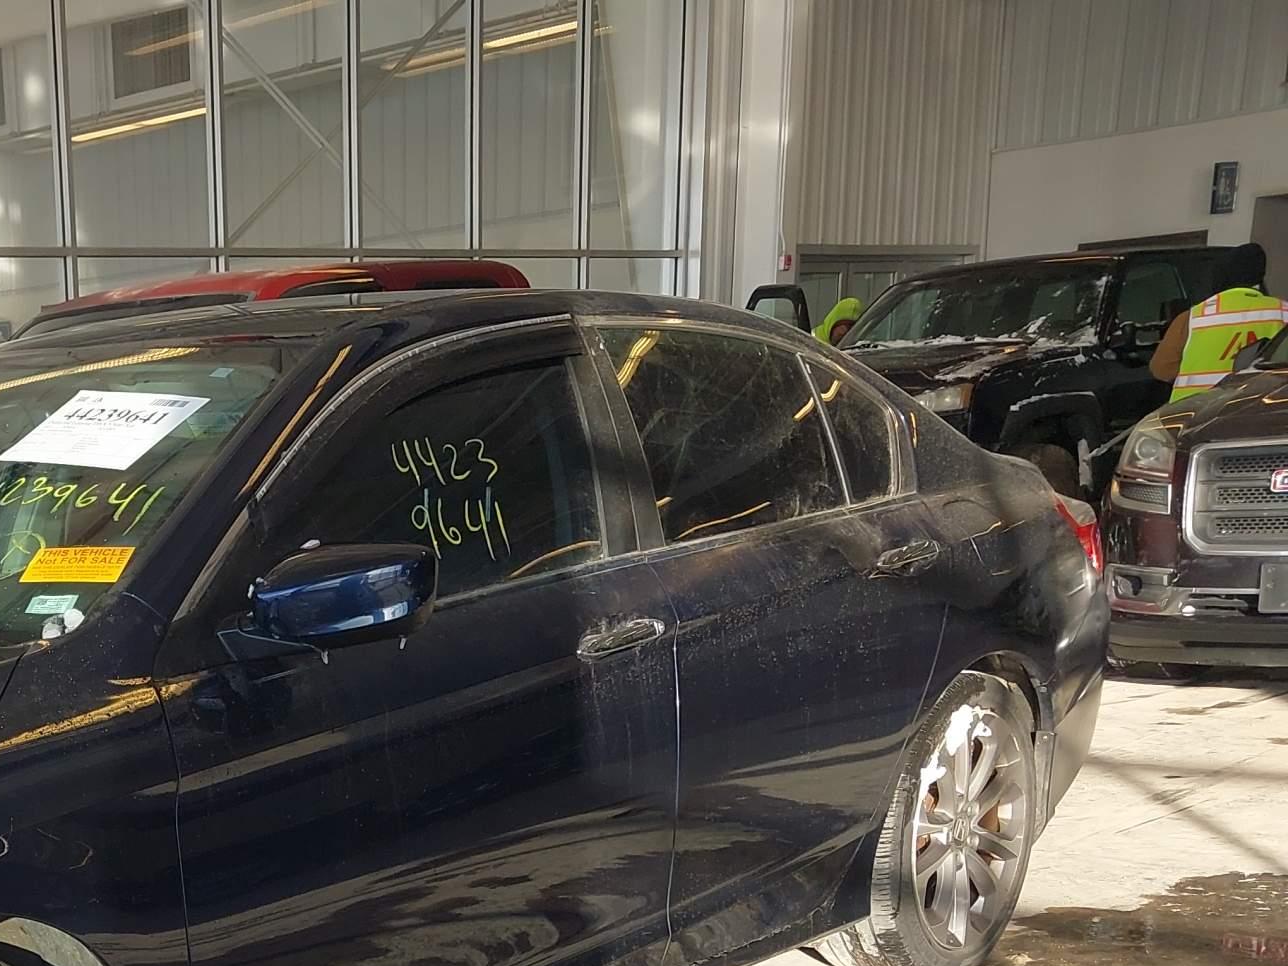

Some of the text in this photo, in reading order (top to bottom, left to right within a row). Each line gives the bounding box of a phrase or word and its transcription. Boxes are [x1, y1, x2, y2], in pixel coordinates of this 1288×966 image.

[64, 408, 170, 424] 44239641
[391, 437, 498, 487] 4423
[411, 495, 511, 562] 9641
[42, 548, 129, 557] THIS VEHICLE
[60, 557, 86, 565] FOR
[89, 557, 126, 565] SALE
